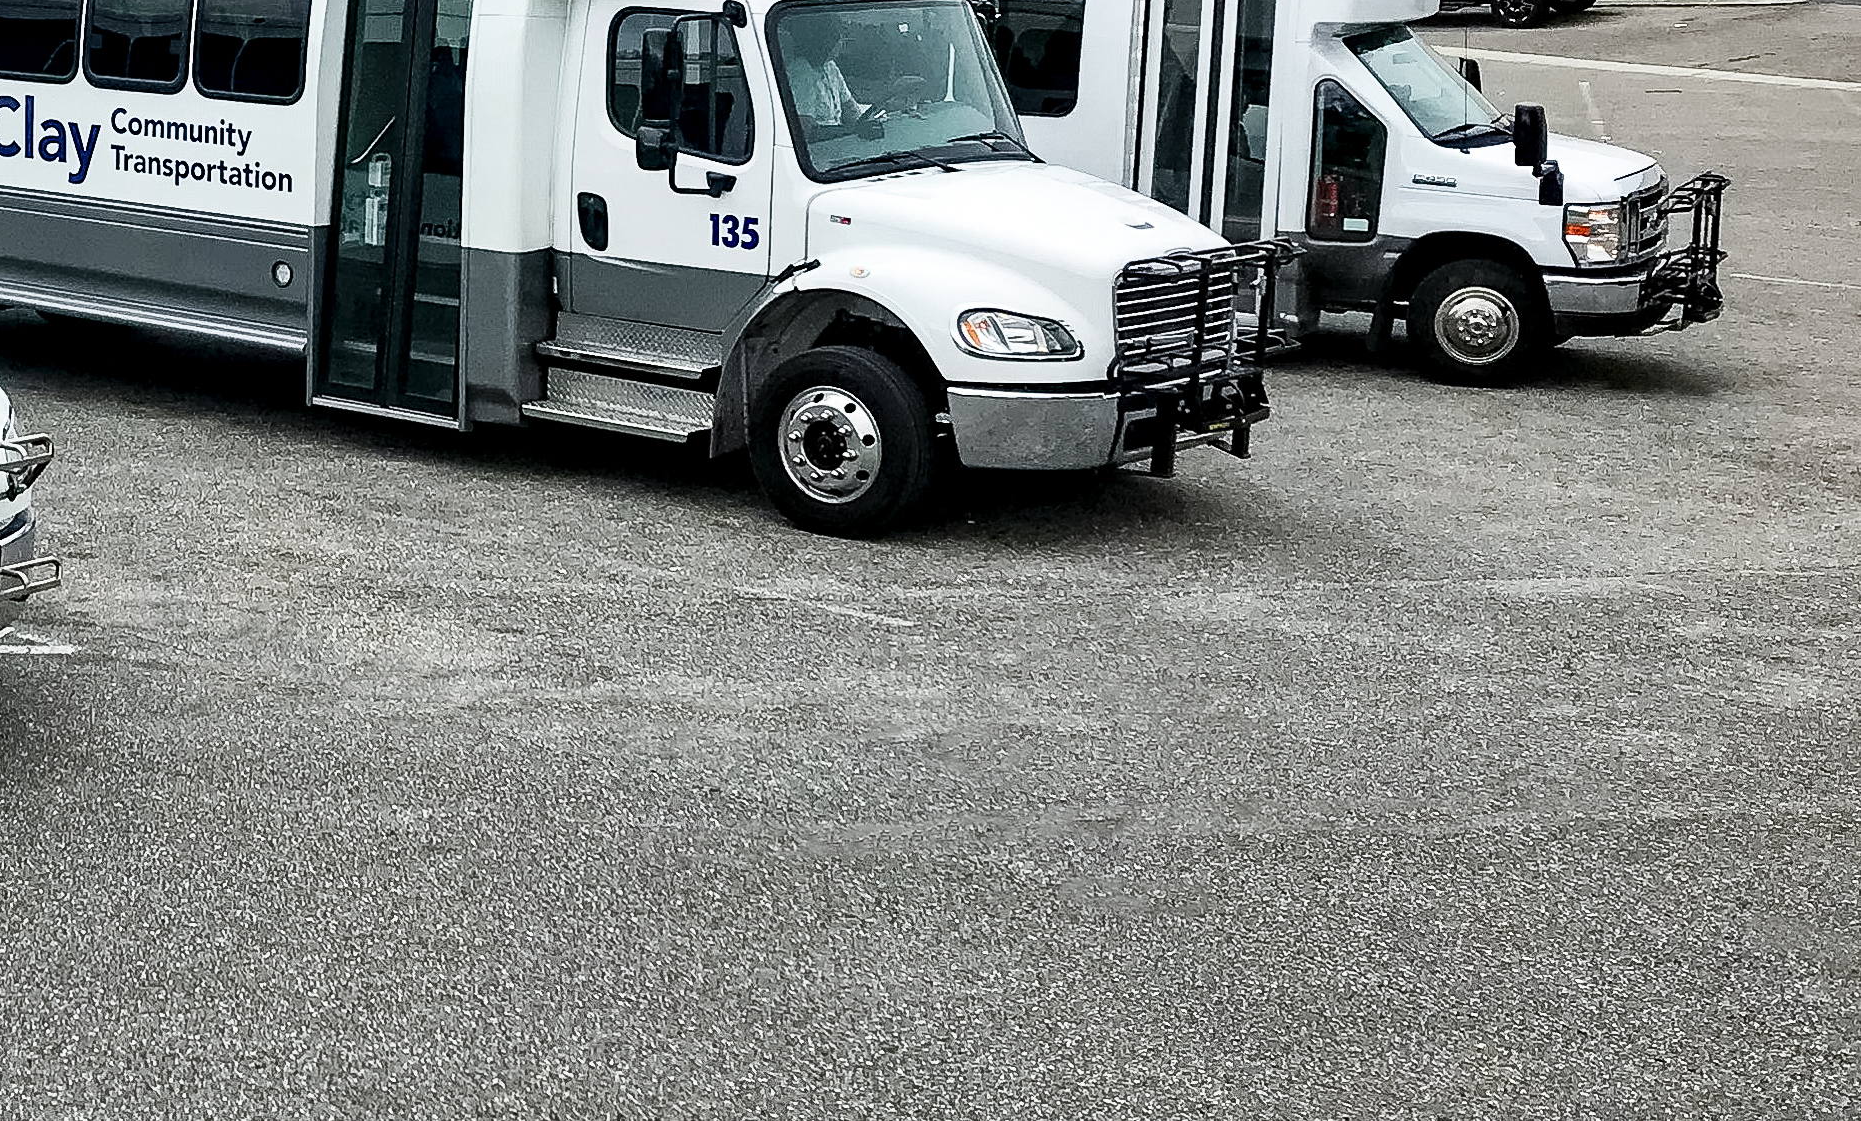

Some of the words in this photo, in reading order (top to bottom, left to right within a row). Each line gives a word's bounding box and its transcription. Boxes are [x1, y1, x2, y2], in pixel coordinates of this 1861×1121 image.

[110, 107, 253, 157] Community
[110, 144, 293, 193] Transportation
[709, 213, 760, 250] 135
